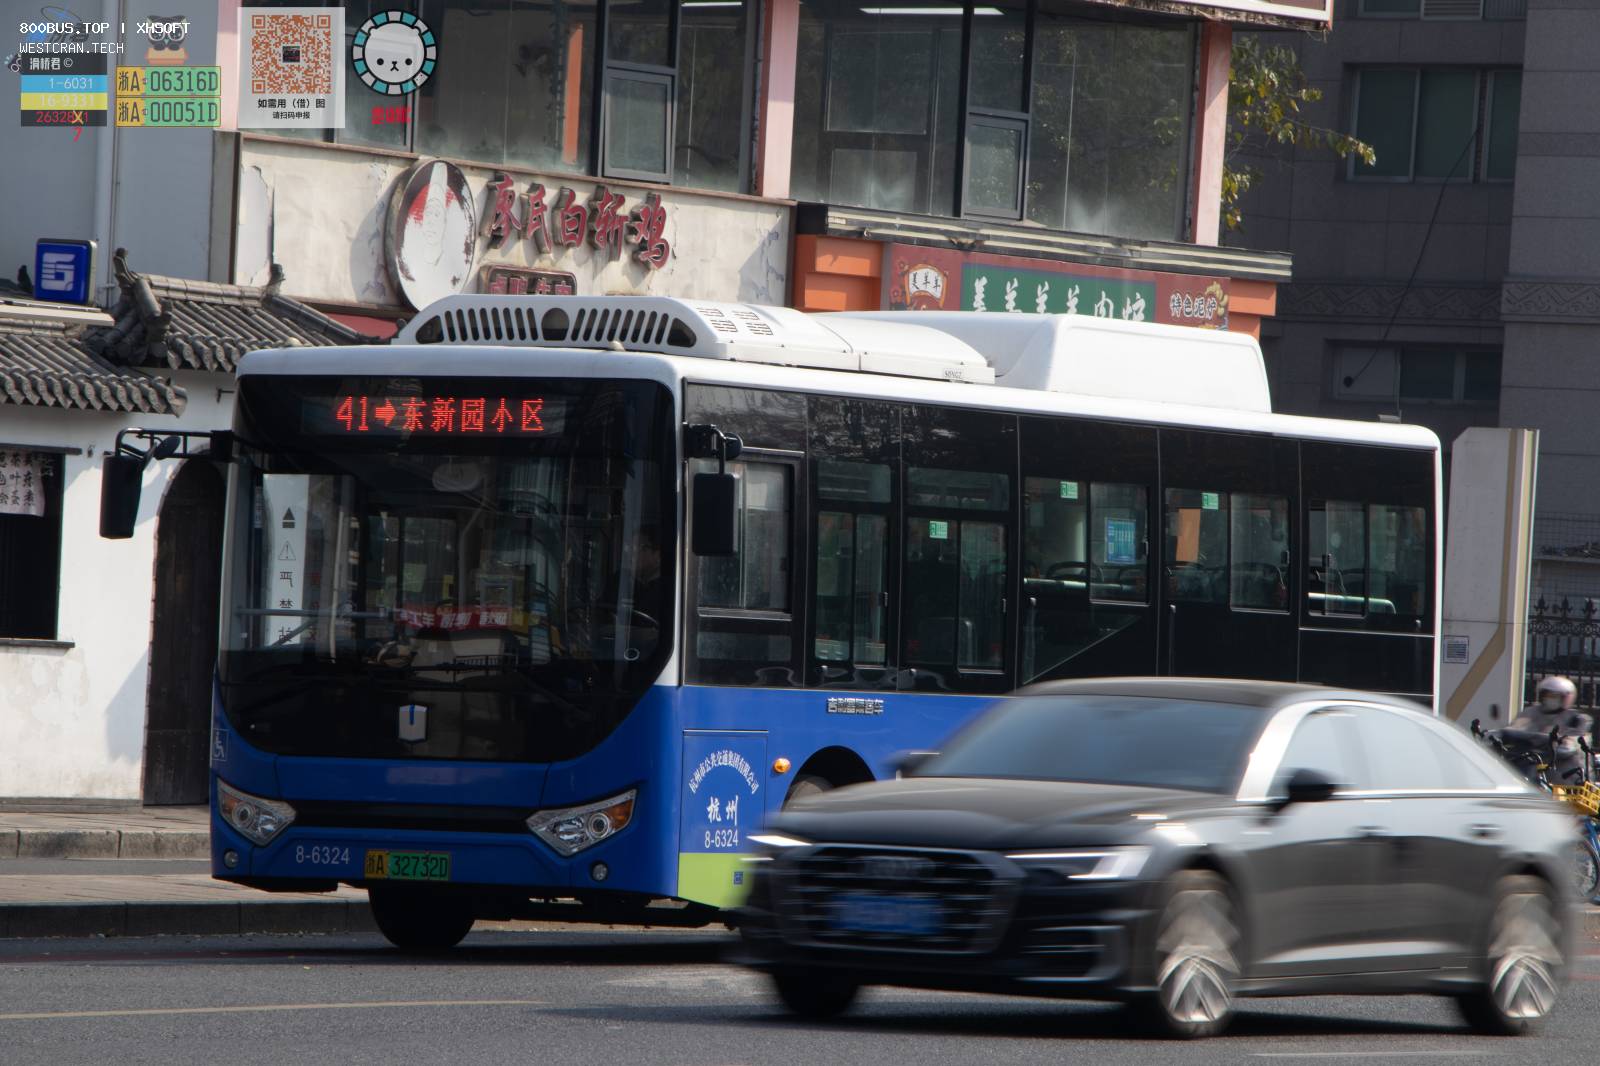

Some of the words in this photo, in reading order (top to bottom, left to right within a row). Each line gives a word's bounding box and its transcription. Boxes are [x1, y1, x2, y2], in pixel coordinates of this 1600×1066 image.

[488, 173, 670, 269] 廖氏白斩鸡
[1169, 292, 1217, 320] 特色泥炉
[335, 396, 369, 431] 41
[402, 396, 545, 432] 东新园小区
[706, 794, 739, 826] 杭州
[704, 829, 739, 849] 8-6324
[295, 845, 351, 866] 8-6324
